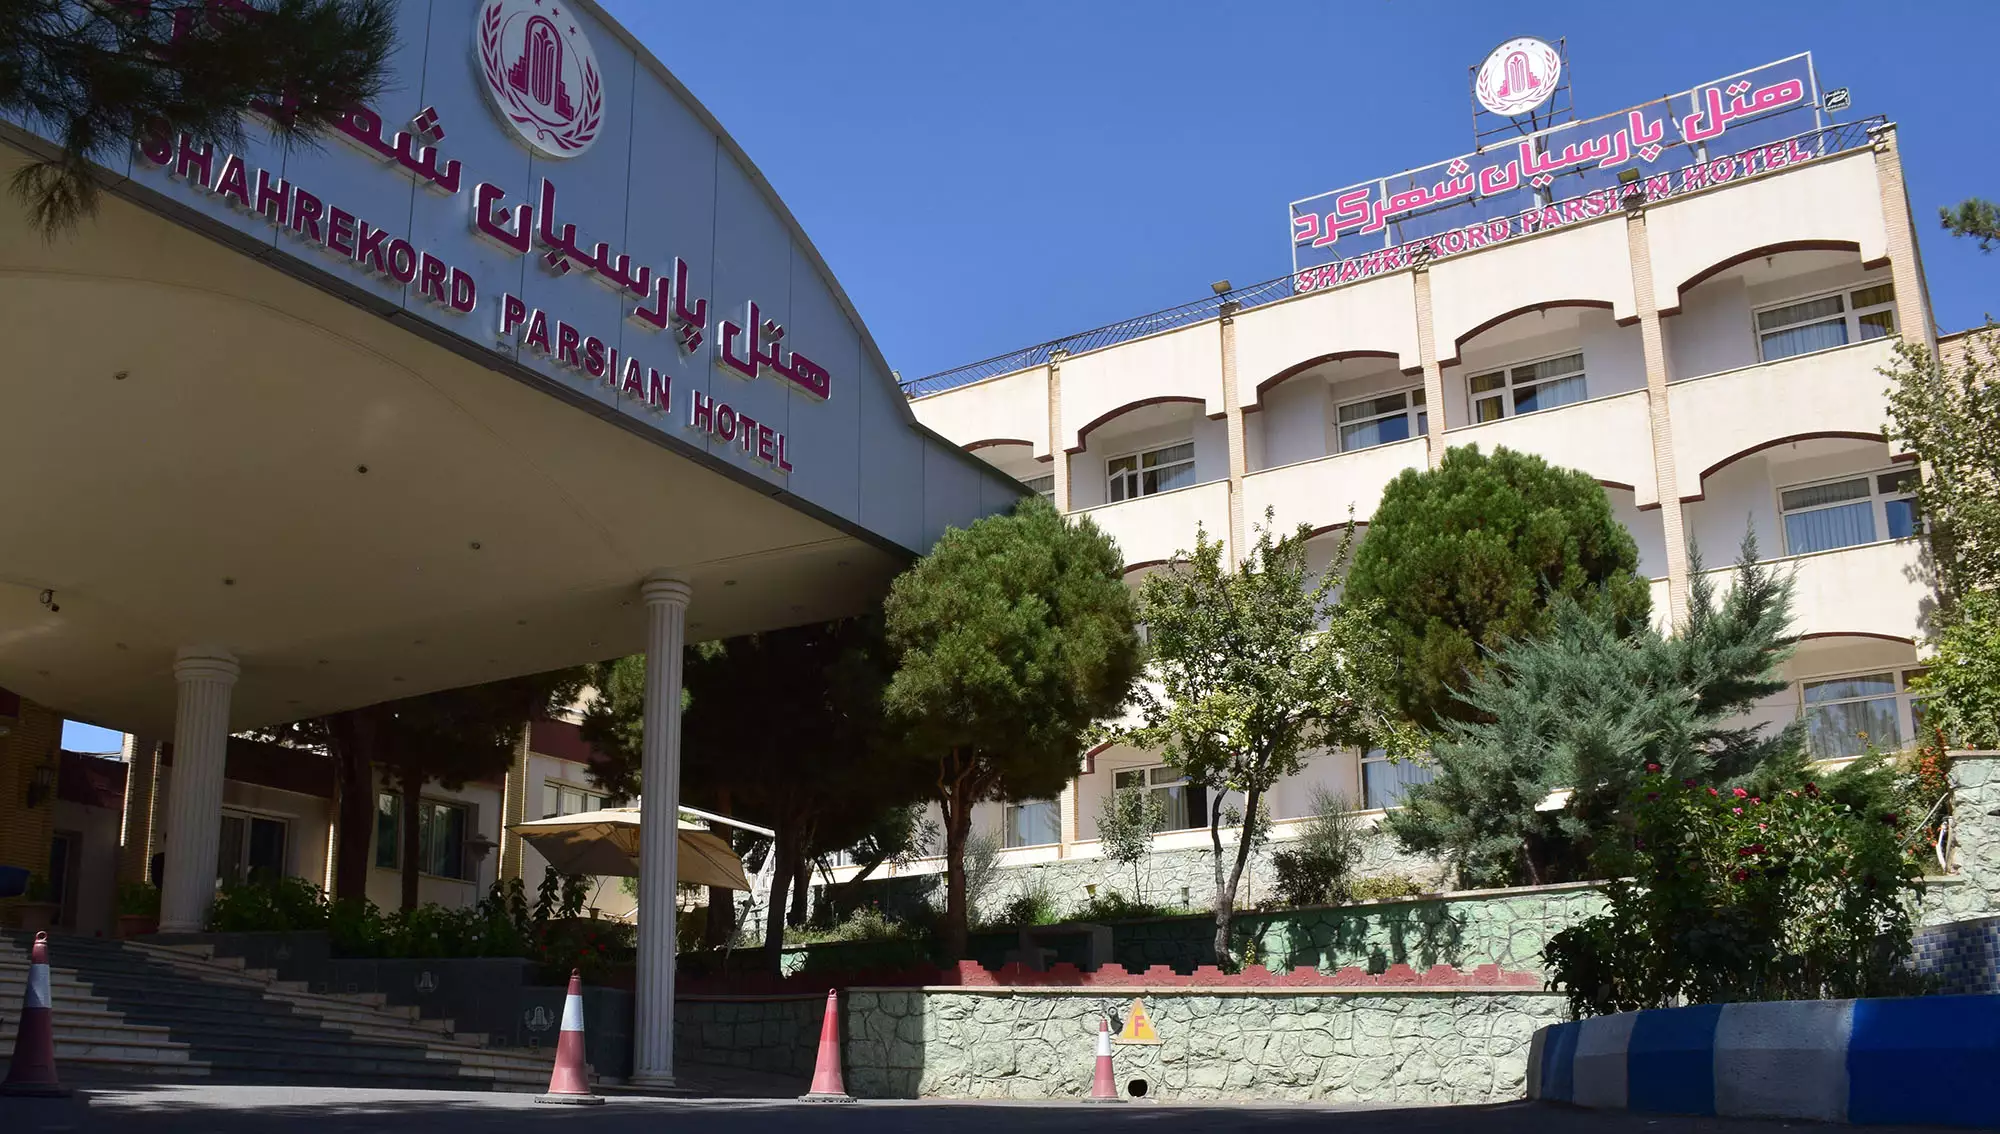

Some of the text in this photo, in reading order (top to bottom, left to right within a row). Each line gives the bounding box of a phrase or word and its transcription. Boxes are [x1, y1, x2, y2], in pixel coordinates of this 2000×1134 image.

[1294, 79, 1804, 249] هتل پارسیان شهرکرد
[1683, 136, 1813, 193] HOTEL
[136, 118, 794, 473] SHAHREKORD PARSIAN HOTEL
[474, 177, 708, 354] پارسیان
[717, 300, 831, 401] هتل
[1134, 1016, 1145, 1036] F
